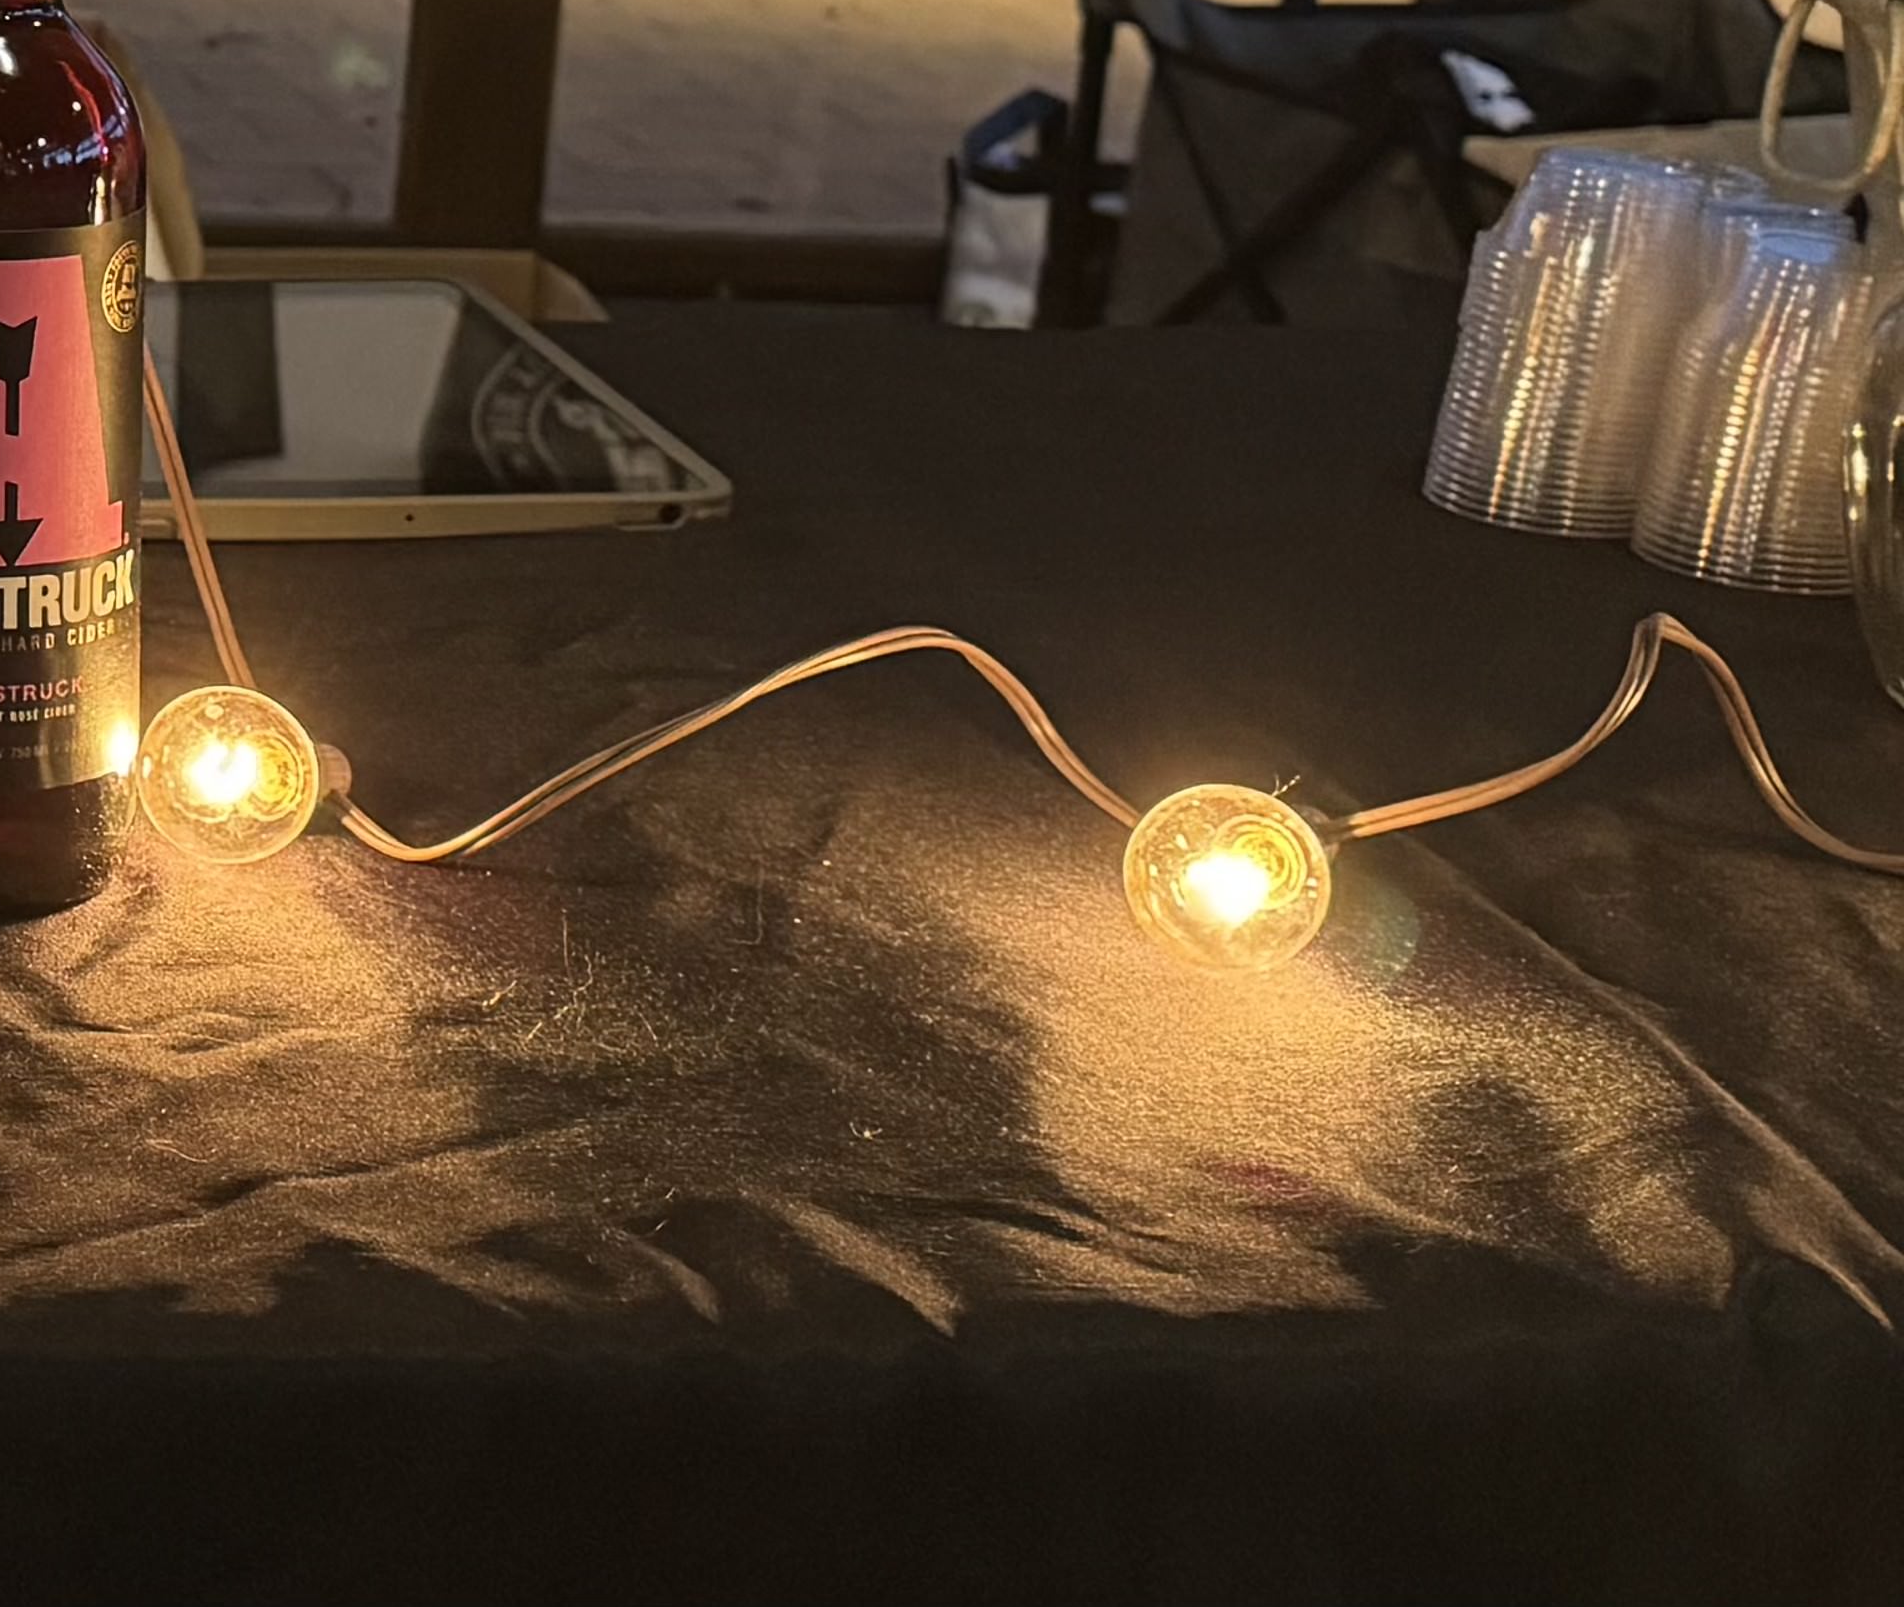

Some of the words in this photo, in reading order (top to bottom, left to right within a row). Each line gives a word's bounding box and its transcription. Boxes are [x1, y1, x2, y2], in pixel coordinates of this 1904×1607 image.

[2, 632, 55, 652] HARD
[68, 618, 115, 646] CIDER
[44, 704, 76, 719] CIDER
